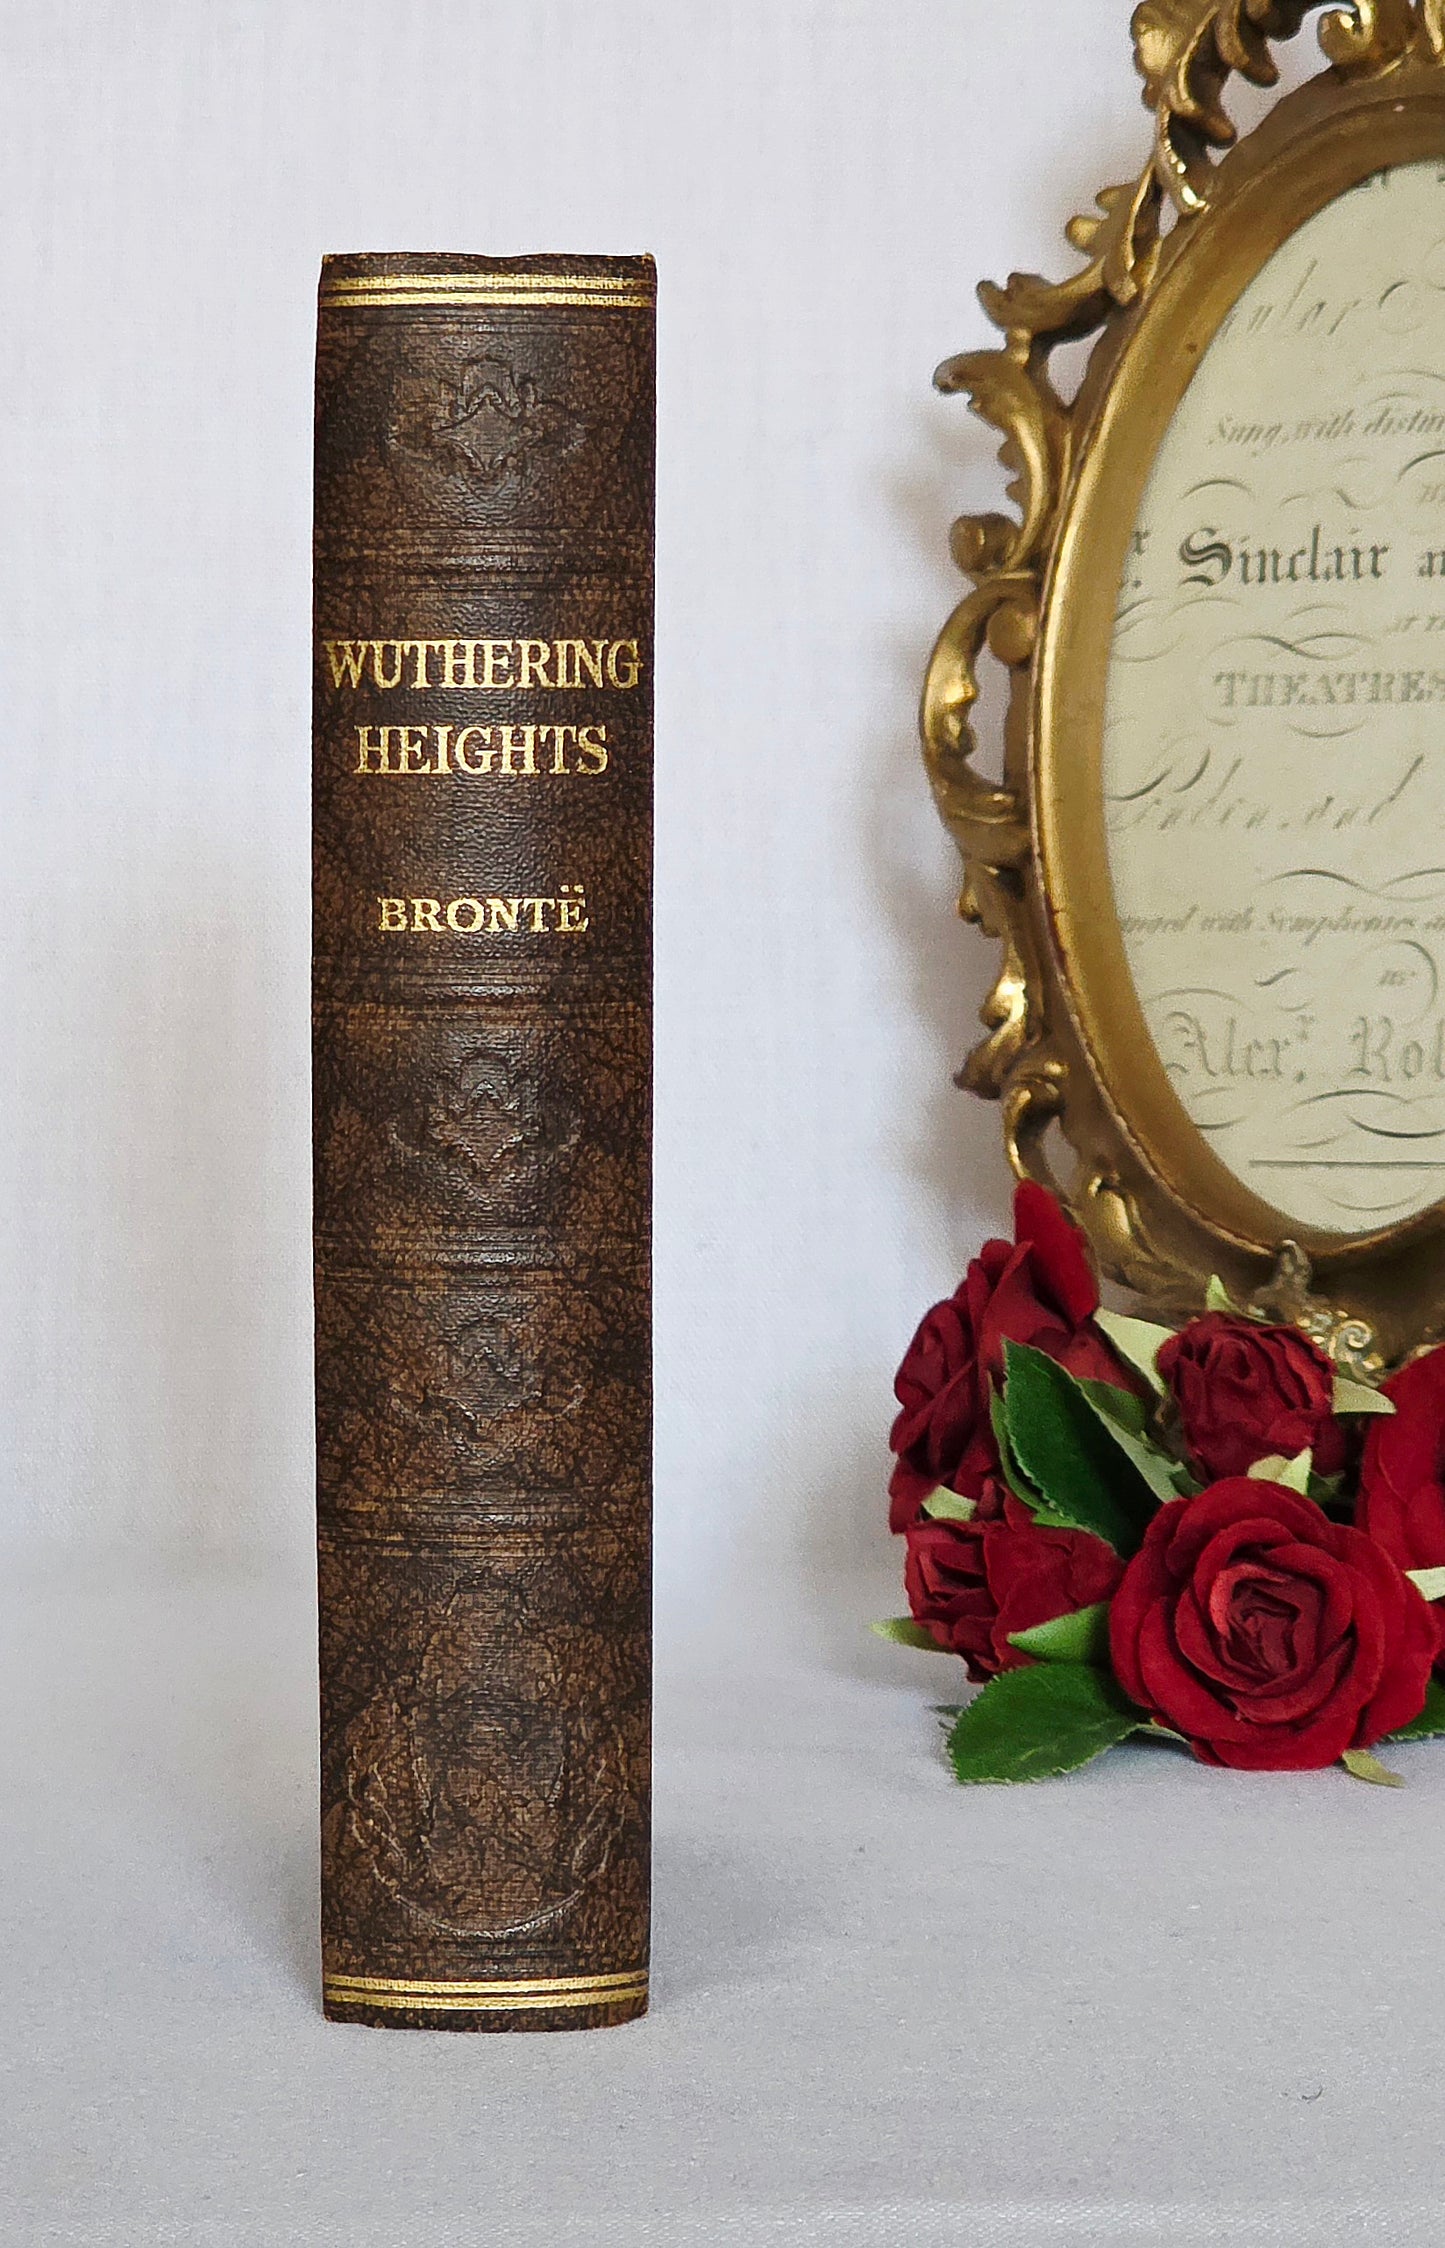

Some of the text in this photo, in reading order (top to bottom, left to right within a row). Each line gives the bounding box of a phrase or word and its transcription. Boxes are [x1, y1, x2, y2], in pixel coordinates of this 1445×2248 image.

[1177, 524, 1391, 588] Sinclair
[322, 638, 645, 690] WUTHERING
[352, 724, 610, 776] HEIGHTS
[376, 884, 591, 933] BRONTË
